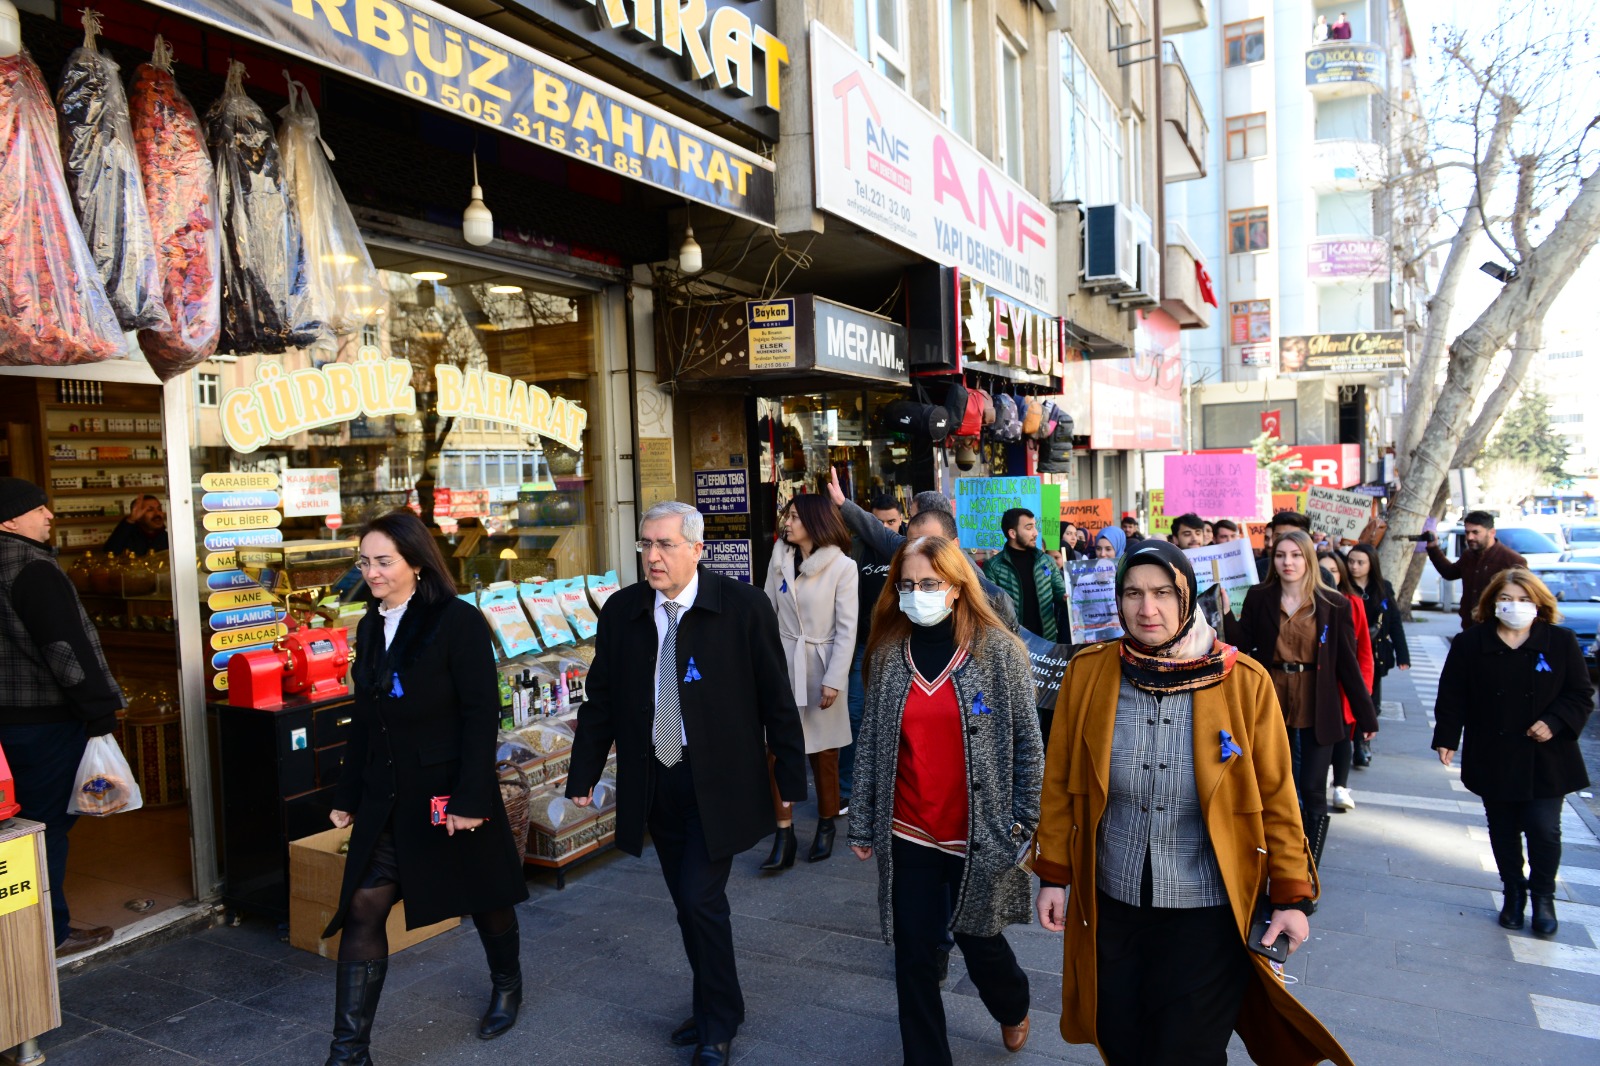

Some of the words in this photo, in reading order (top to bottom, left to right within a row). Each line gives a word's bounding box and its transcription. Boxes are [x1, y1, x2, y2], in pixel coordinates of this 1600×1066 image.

[404, 70, 428, 97] 0
[440, 84, 503, 126] 505
[512, 112, 567, 150] 315
[574, 136, 604, 164] 31
[613, 151, 643, 178] 85
[533, 69, 753, 196] BAHARAT
[866, 117, 910, 165] ANF
[933, 134, 1046, 254] ANF
[888, 198, 899, 217] 32
[901, 205, 911, 223] 00
[934, 216, 963, 262] YAPI
[967, 234, 1013, 286] DENETİM
[755, 307, 786, 319] Baykan
[826, 316, 896, 369] MERAM
[222, 346, 414, 450] GÜRBÜZ
[436, 365, 585, 449] BAHARAT
[211, 476, 269, 487] KARABİBER
[1021, 477, 1037, 494] BİR
[222, 495, 262, 507] KİMYON
[296, 499, 329, 510] ÇEKİLİR
[216, 516, 236, 526] PUL
[240, 514, 269, 525] BİBER
[209, 536, 237, 548] TÜRK
[238, 533, 279, 547] KAHVESİ
[234, 592, 261, 604] NANE
[226, 609, 272, 625] IHLAMUR
[221, 634, 234, 645] EV
[237, 628, 277, 643] SALÇAS
